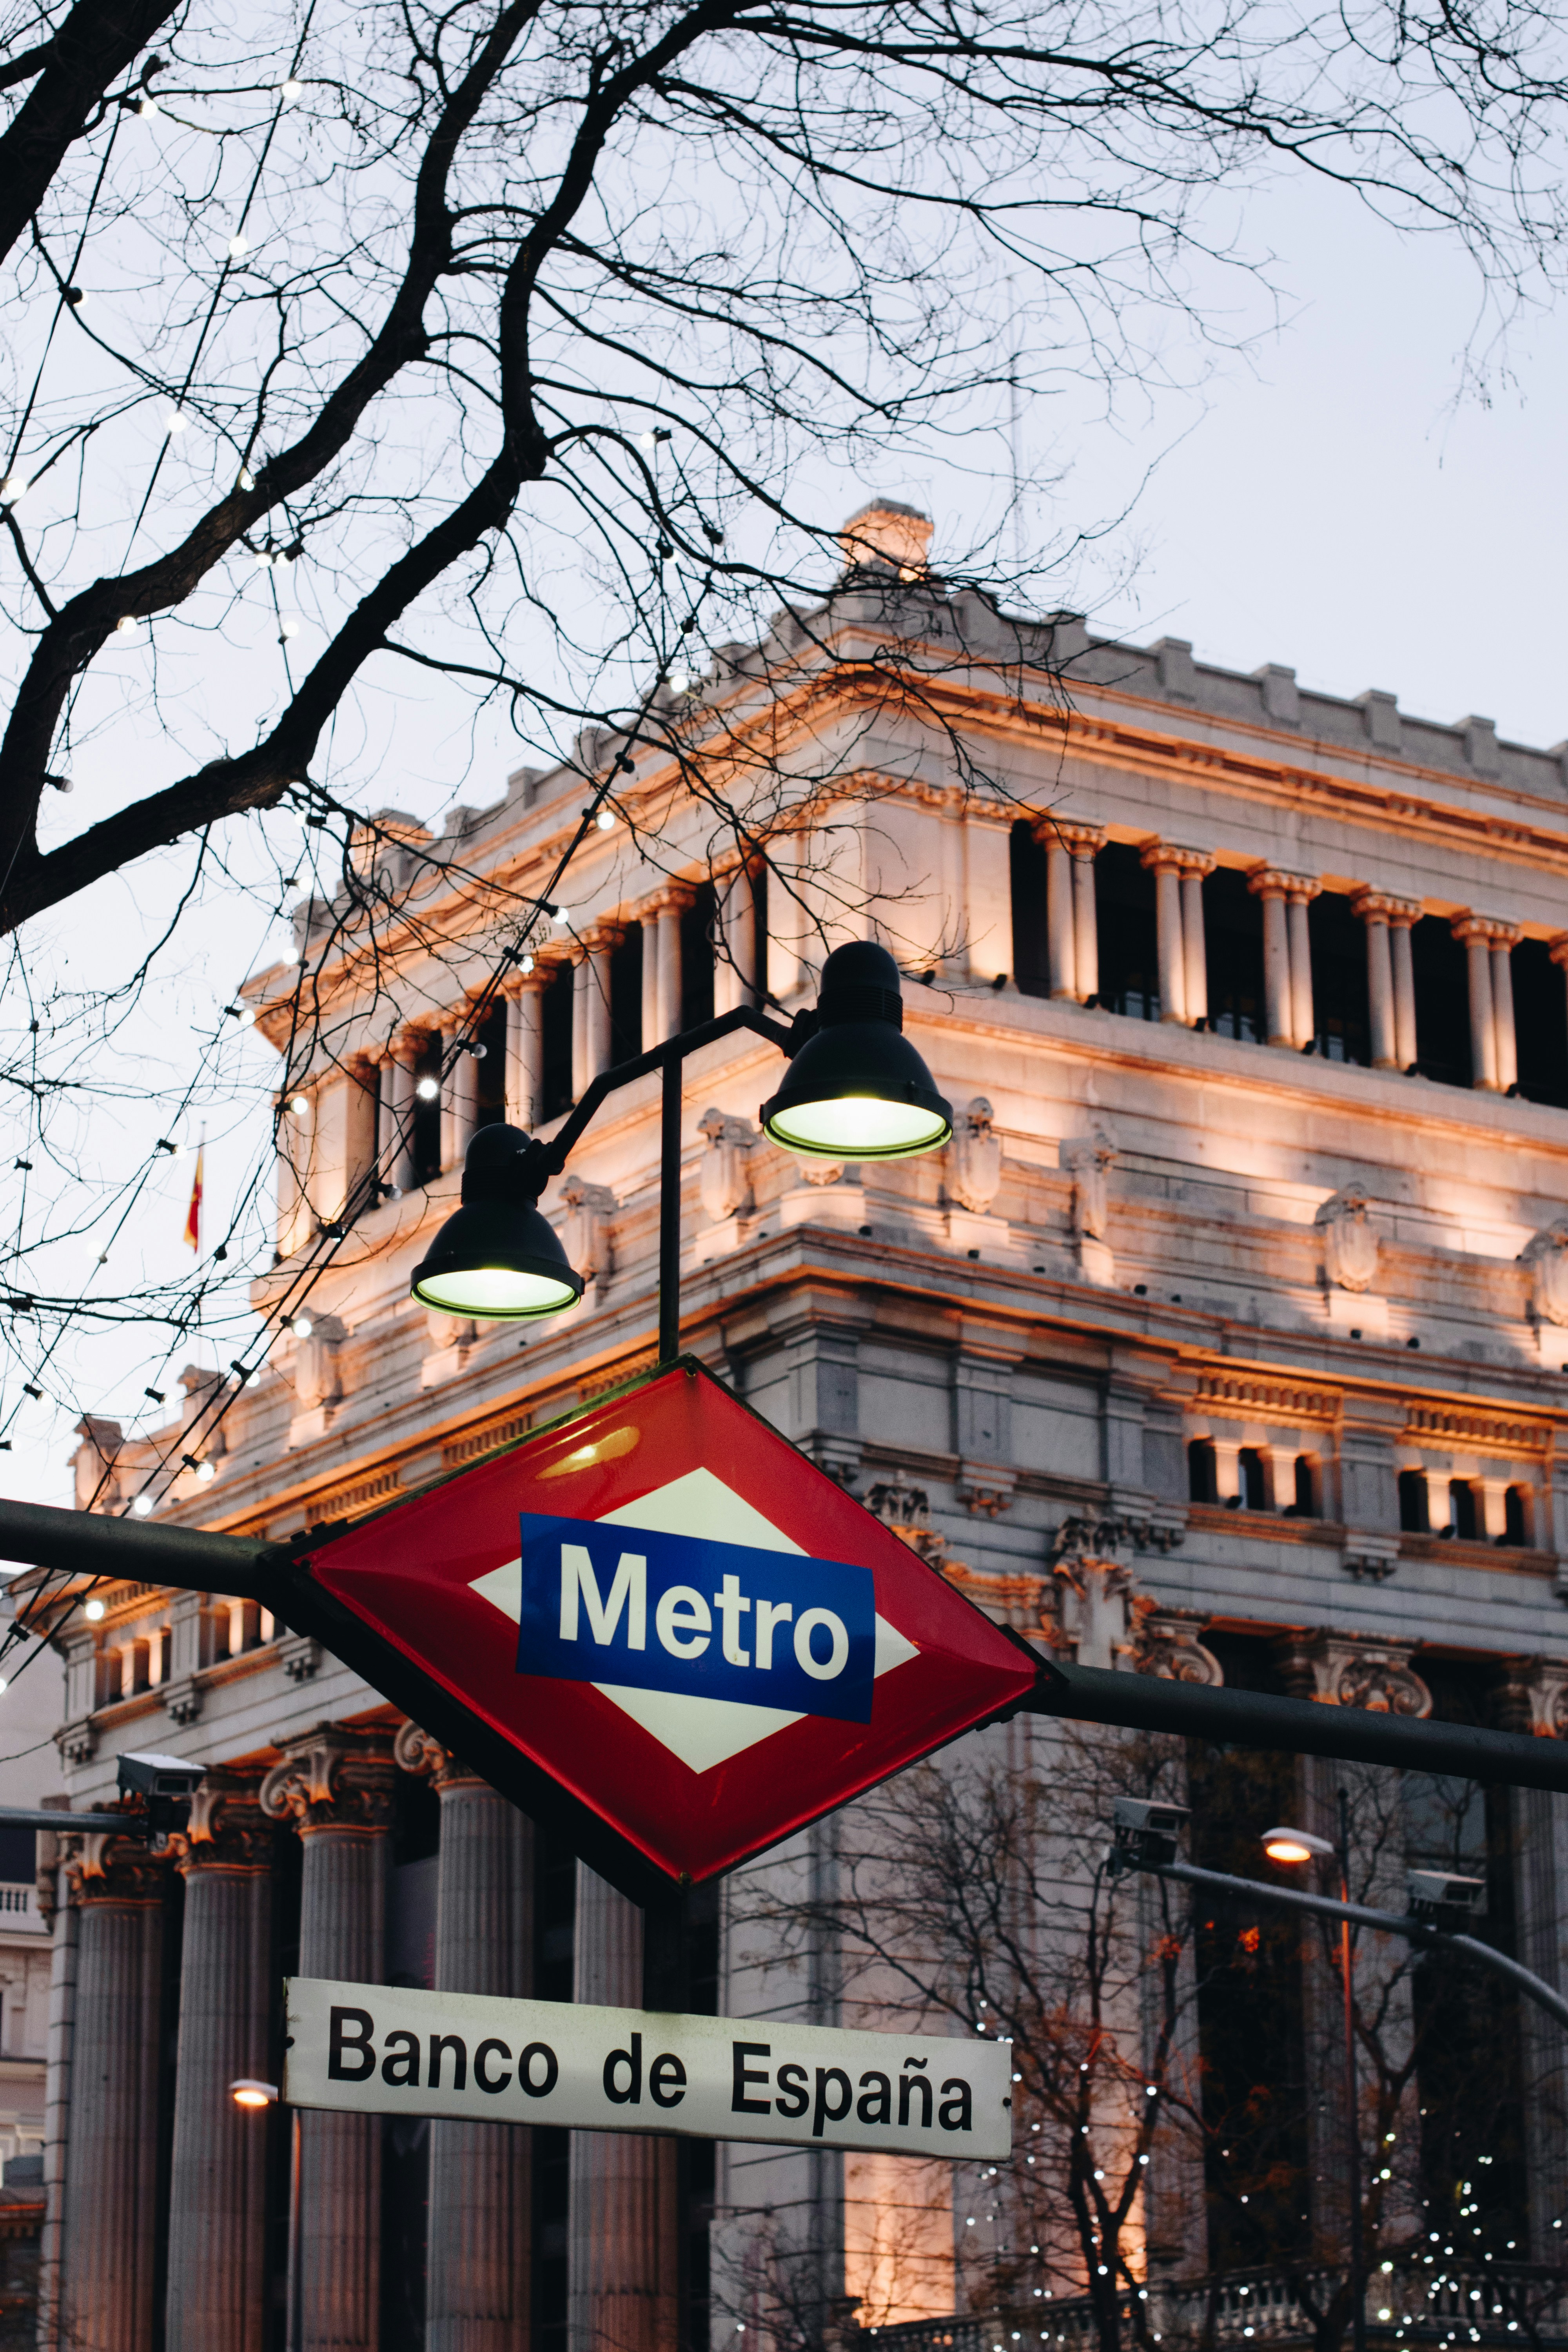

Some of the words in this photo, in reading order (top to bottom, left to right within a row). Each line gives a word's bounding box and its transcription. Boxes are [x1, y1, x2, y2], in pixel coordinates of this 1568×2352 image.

[559, 1543, 849, 1681] Metro
[328, 2005, 559, 2098] Banco
[603, 2032, 687, 2108] de
[731, 2041, 972, 2136] España
